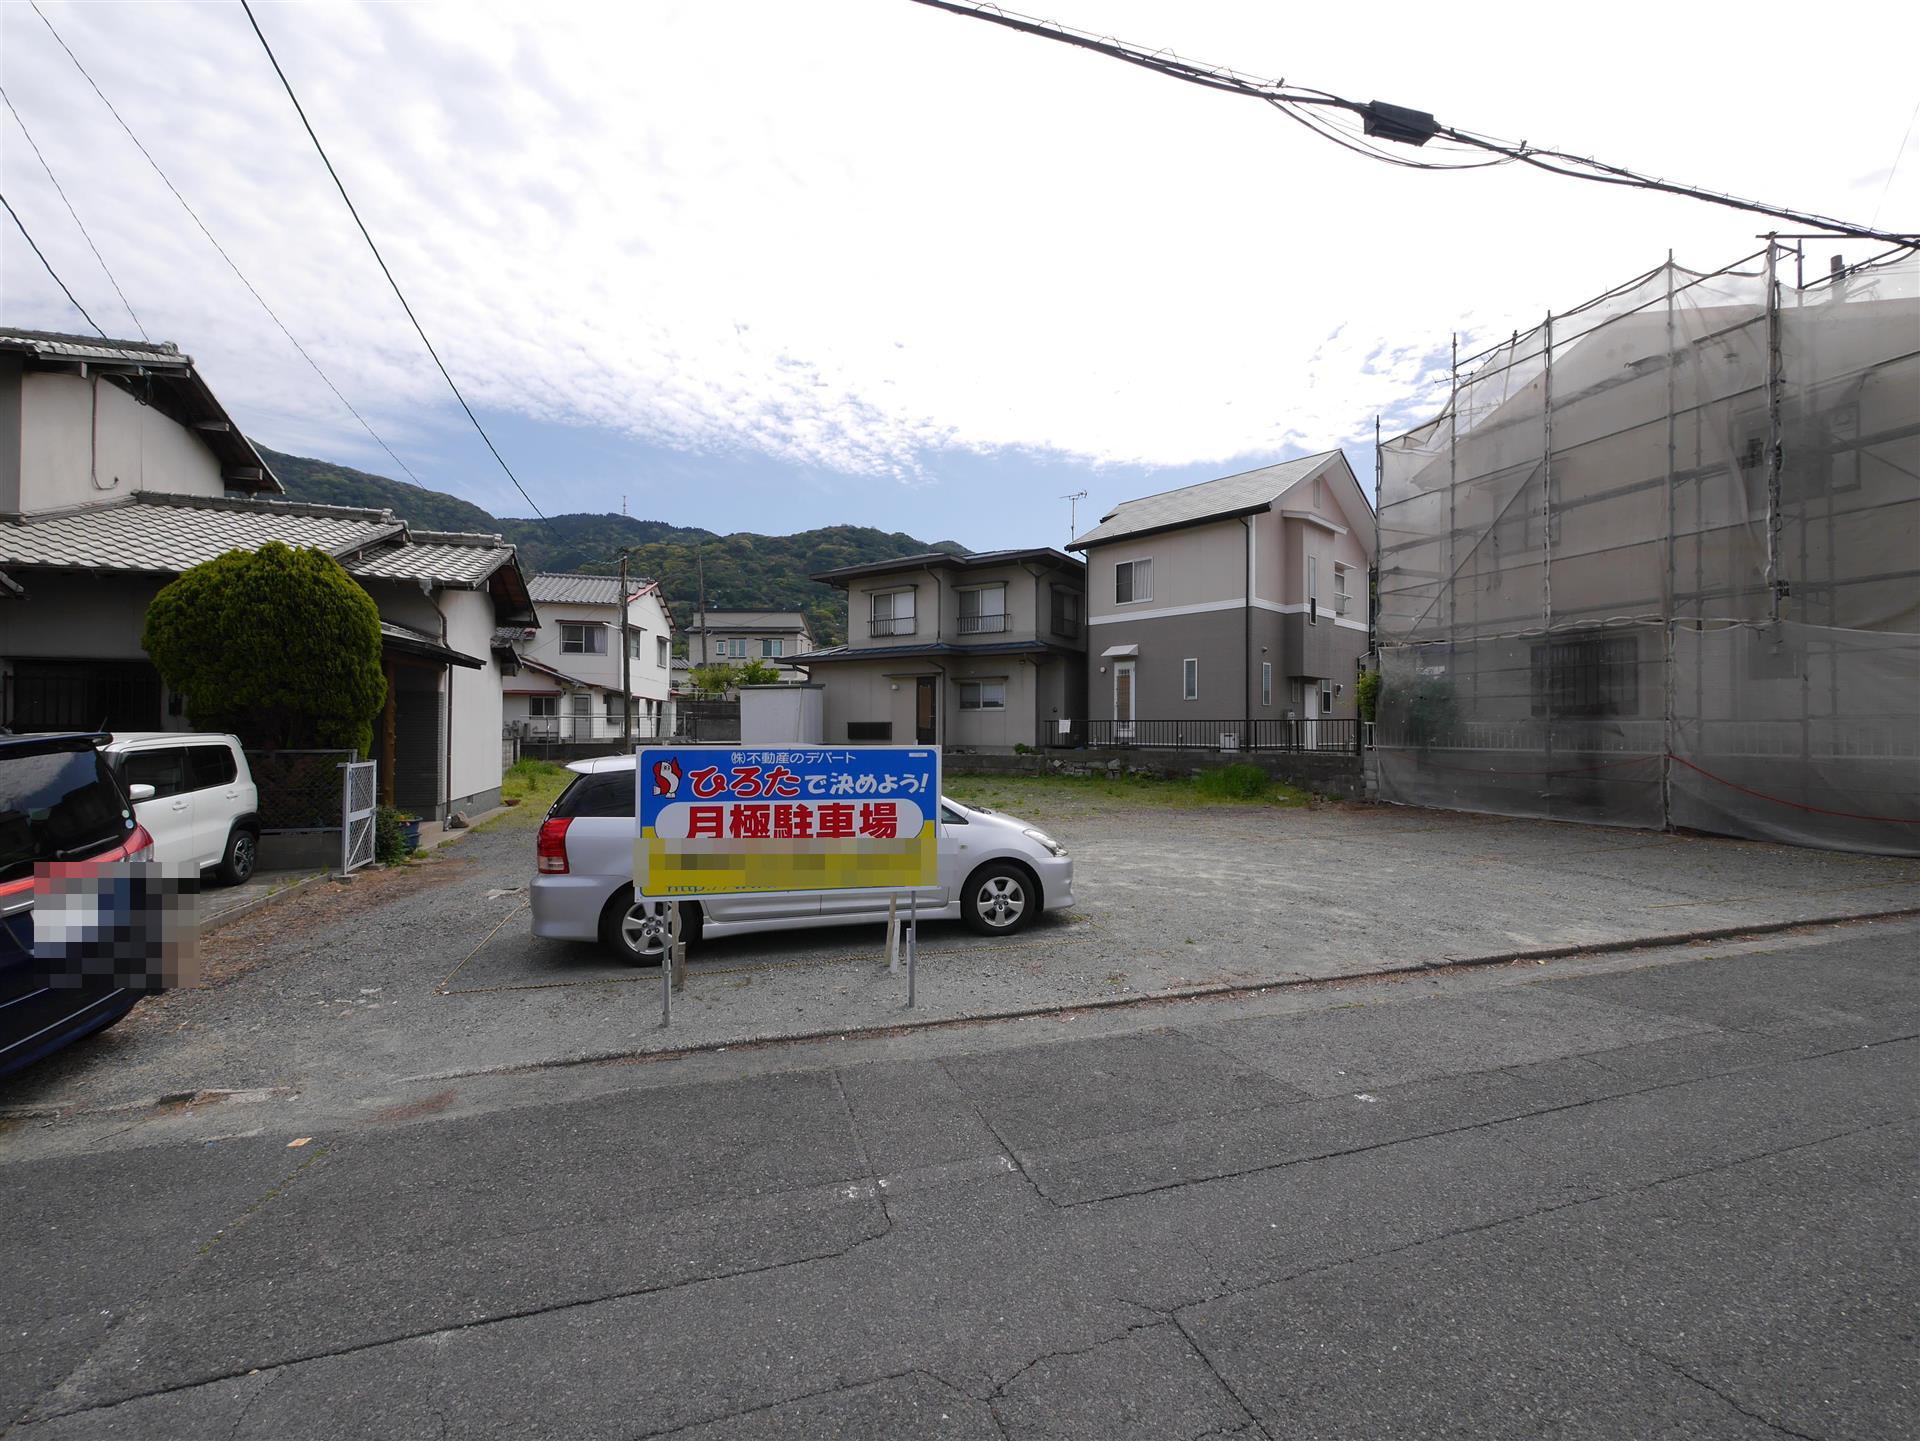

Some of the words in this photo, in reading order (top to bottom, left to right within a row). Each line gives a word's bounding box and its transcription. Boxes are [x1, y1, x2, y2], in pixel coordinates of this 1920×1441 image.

[687, 802, 898, 839] 月極駐車場
